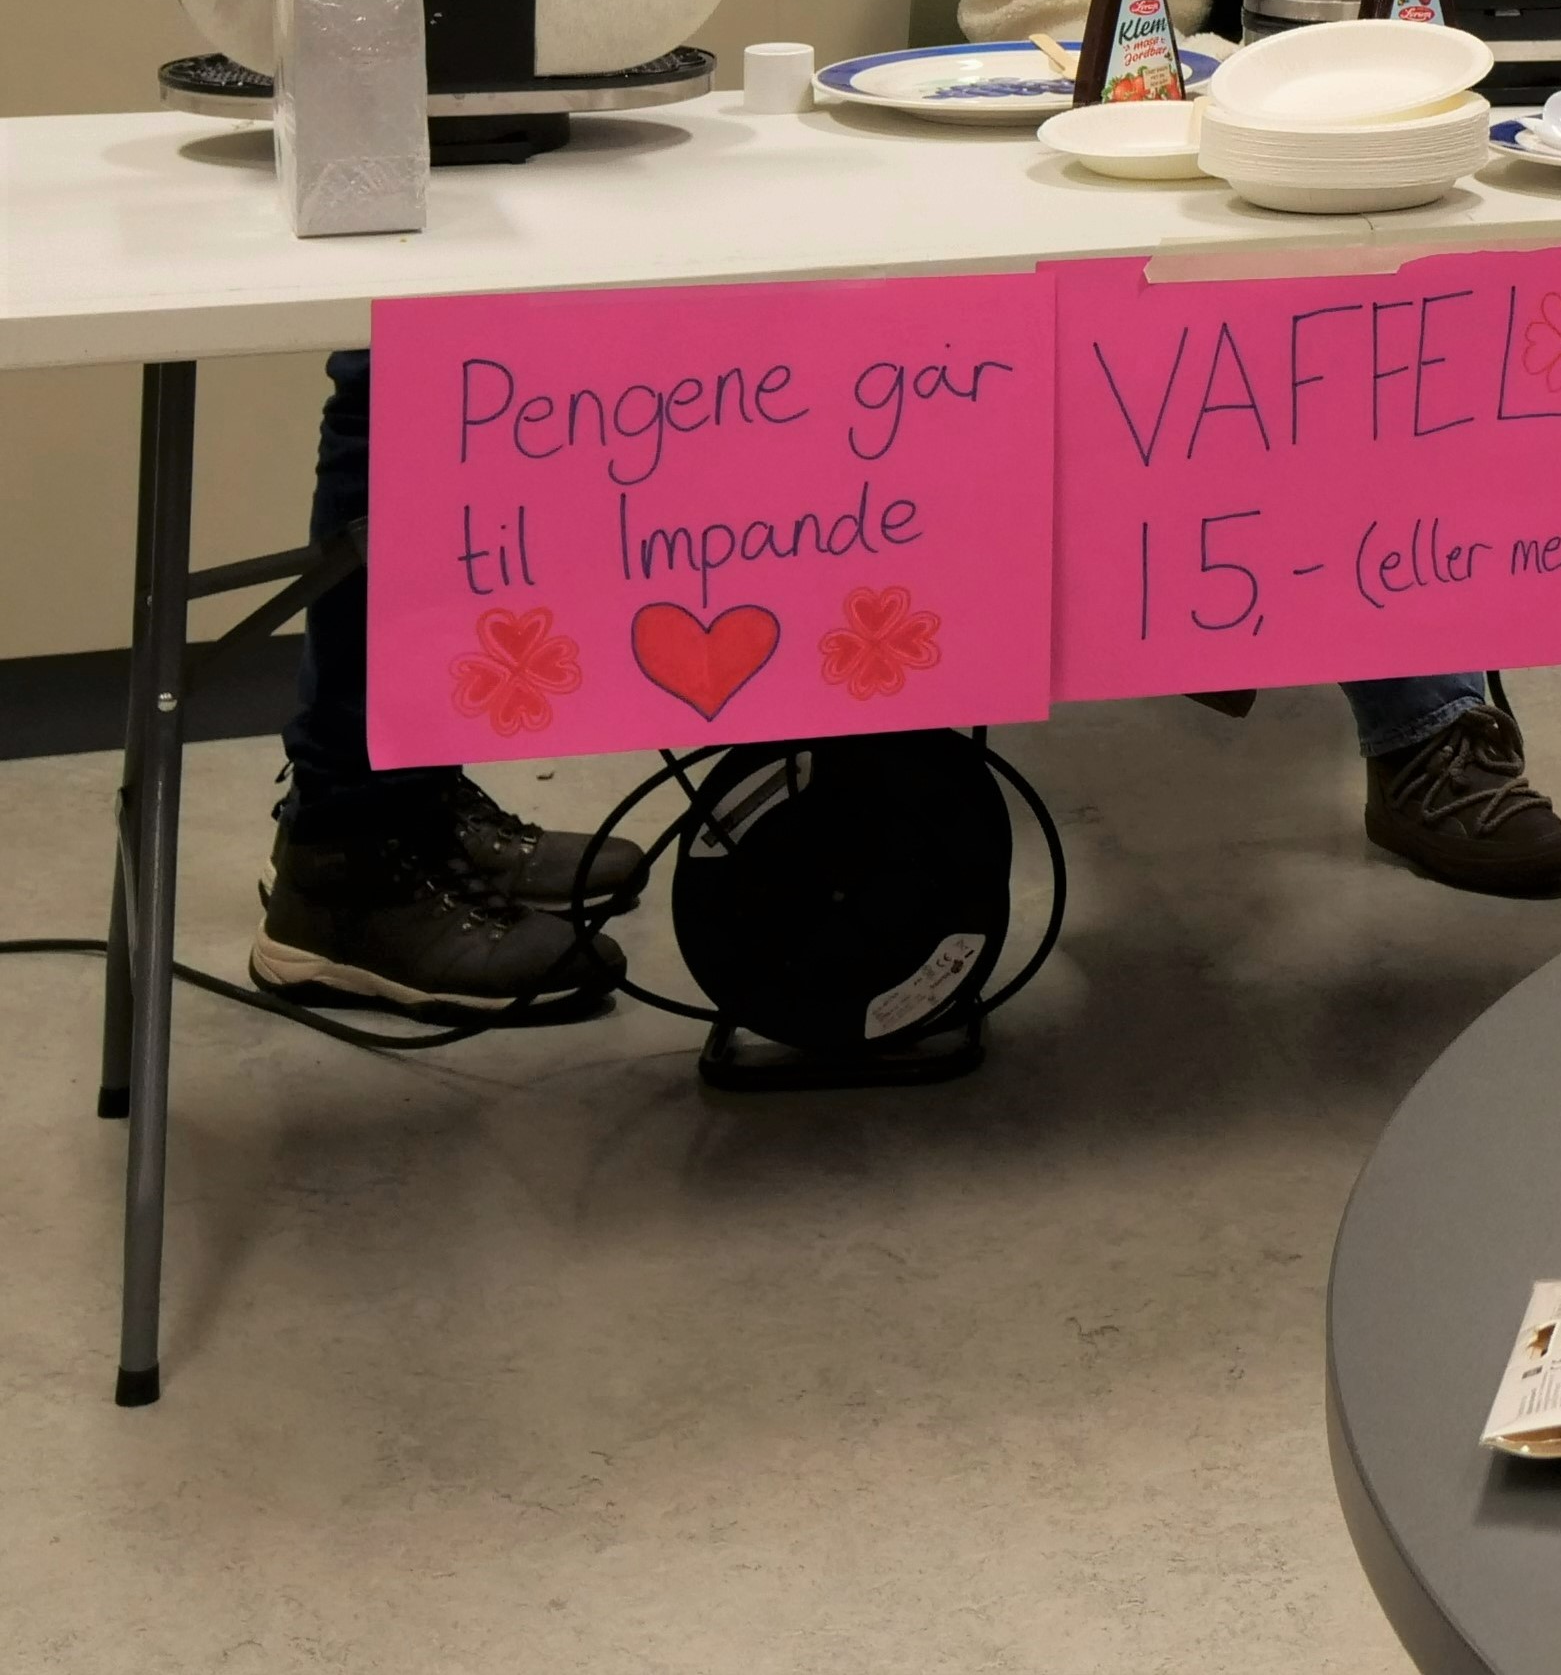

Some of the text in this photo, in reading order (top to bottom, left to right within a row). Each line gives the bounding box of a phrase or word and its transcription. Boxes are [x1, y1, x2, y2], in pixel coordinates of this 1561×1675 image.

[1119, 17, 1168, 45] Klem
[460, 358, 811, 486] Pengene
[457, 481, 924, 609] til Impande
[1139, 509, 1325, 641] 15,-
[1356, 516, 1494, 609] (eller
